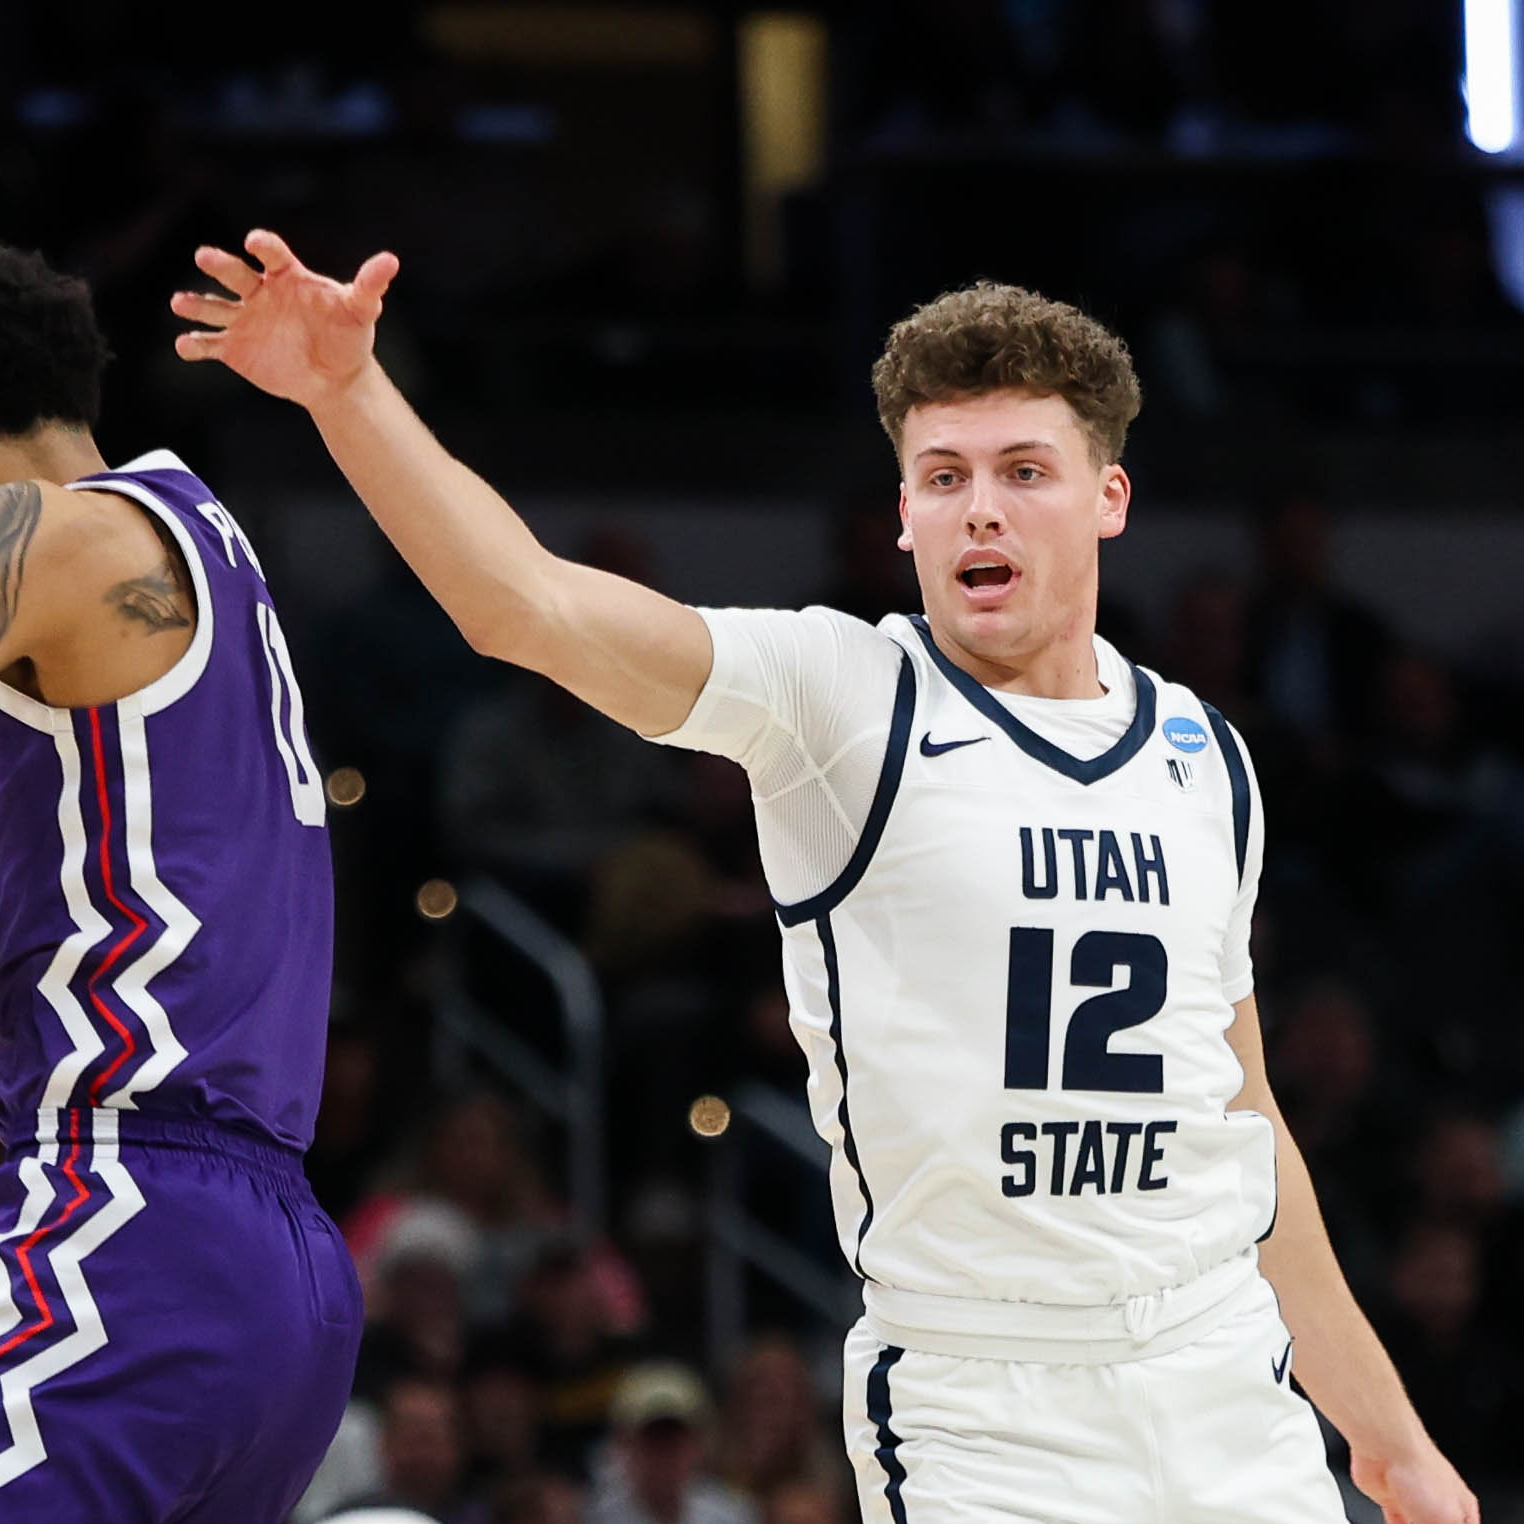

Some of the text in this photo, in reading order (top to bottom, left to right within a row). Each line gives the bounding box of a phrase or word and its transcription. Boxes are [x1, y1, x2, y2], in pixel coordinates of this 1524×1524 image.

[1170, 731, 1207, 744] NCAA
[1019, 826, 1170, 906] UTAH
[1003, 926, 1169, 1094] 12
[1000, 1120, 1178, 1198] STATE
